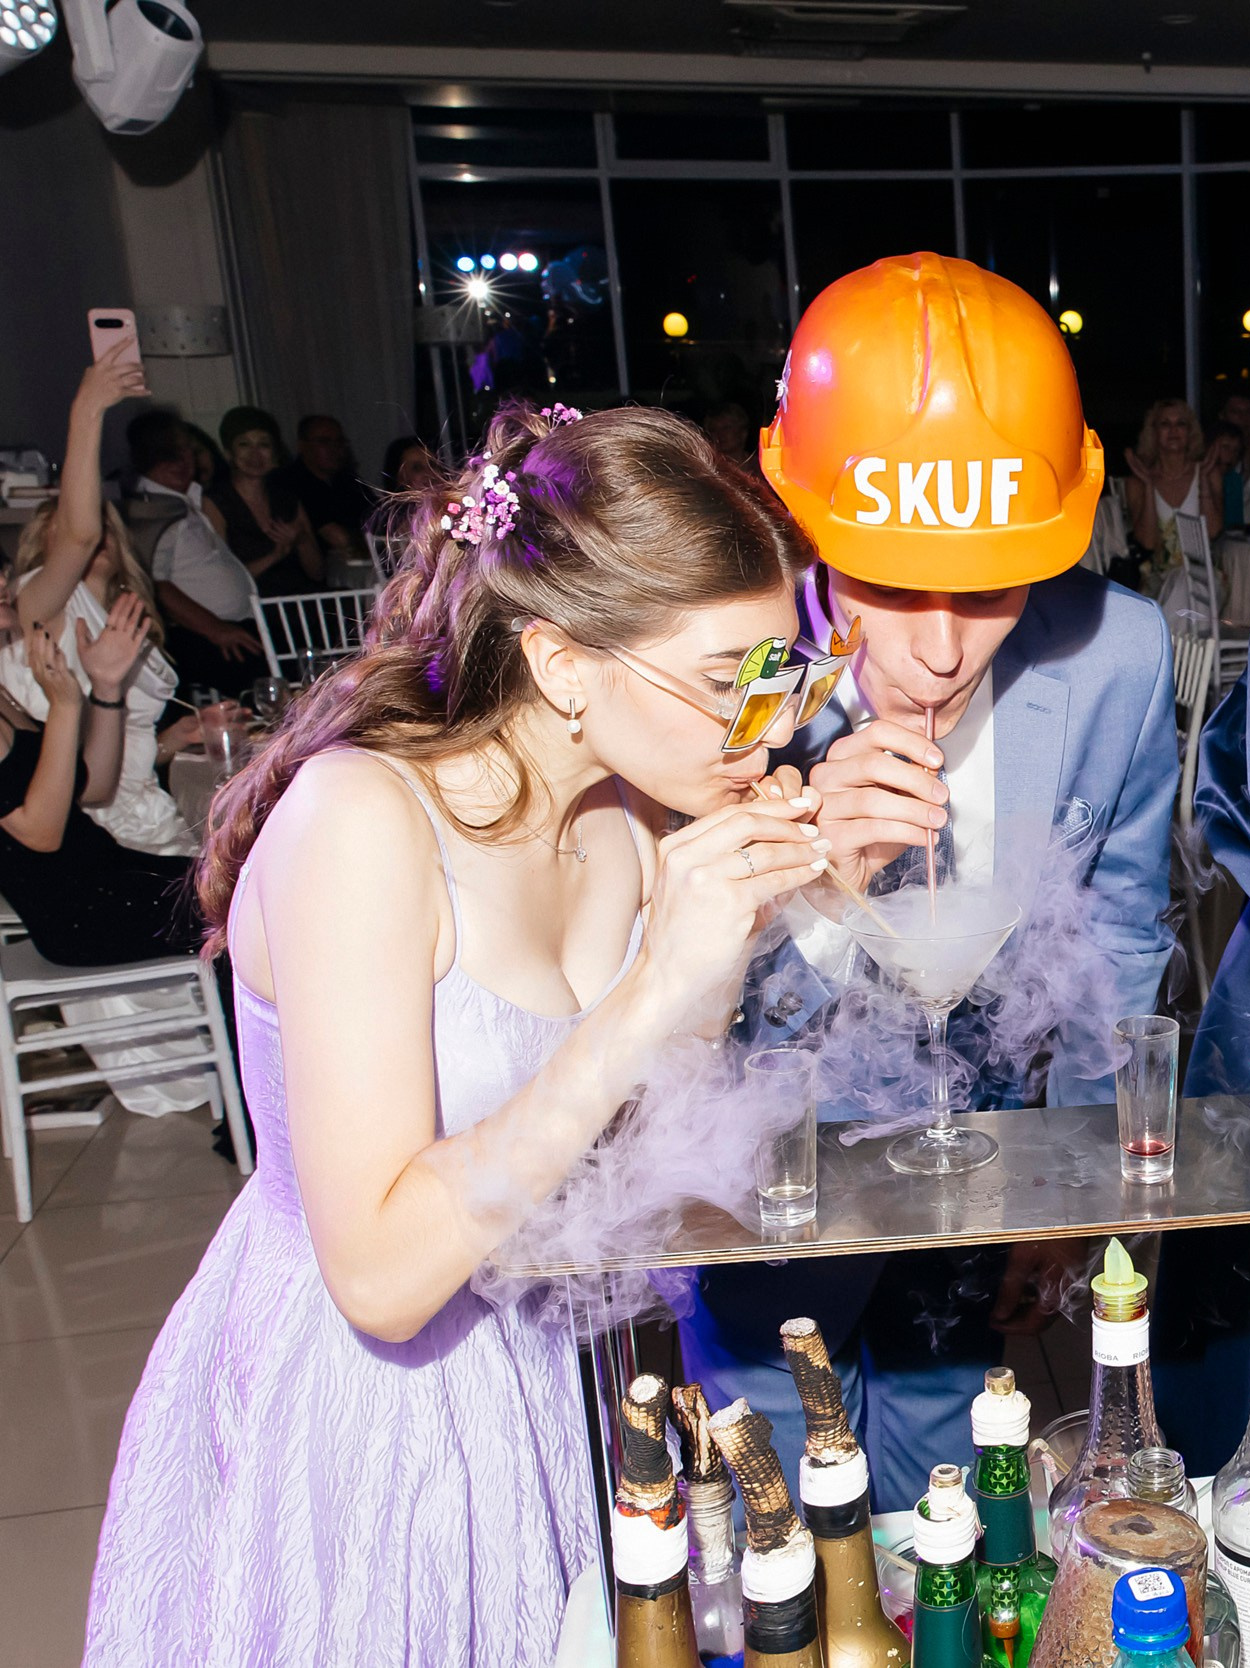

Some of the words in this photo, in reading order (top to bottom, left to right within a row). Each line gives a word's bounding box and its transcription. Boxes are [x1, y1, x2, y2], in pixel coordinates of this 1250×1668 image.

[853, 456, 1023, 528] SKUF
[768, 651, 782, 661] salt
[1094, 1349, 1119, 1361] RIOBA
